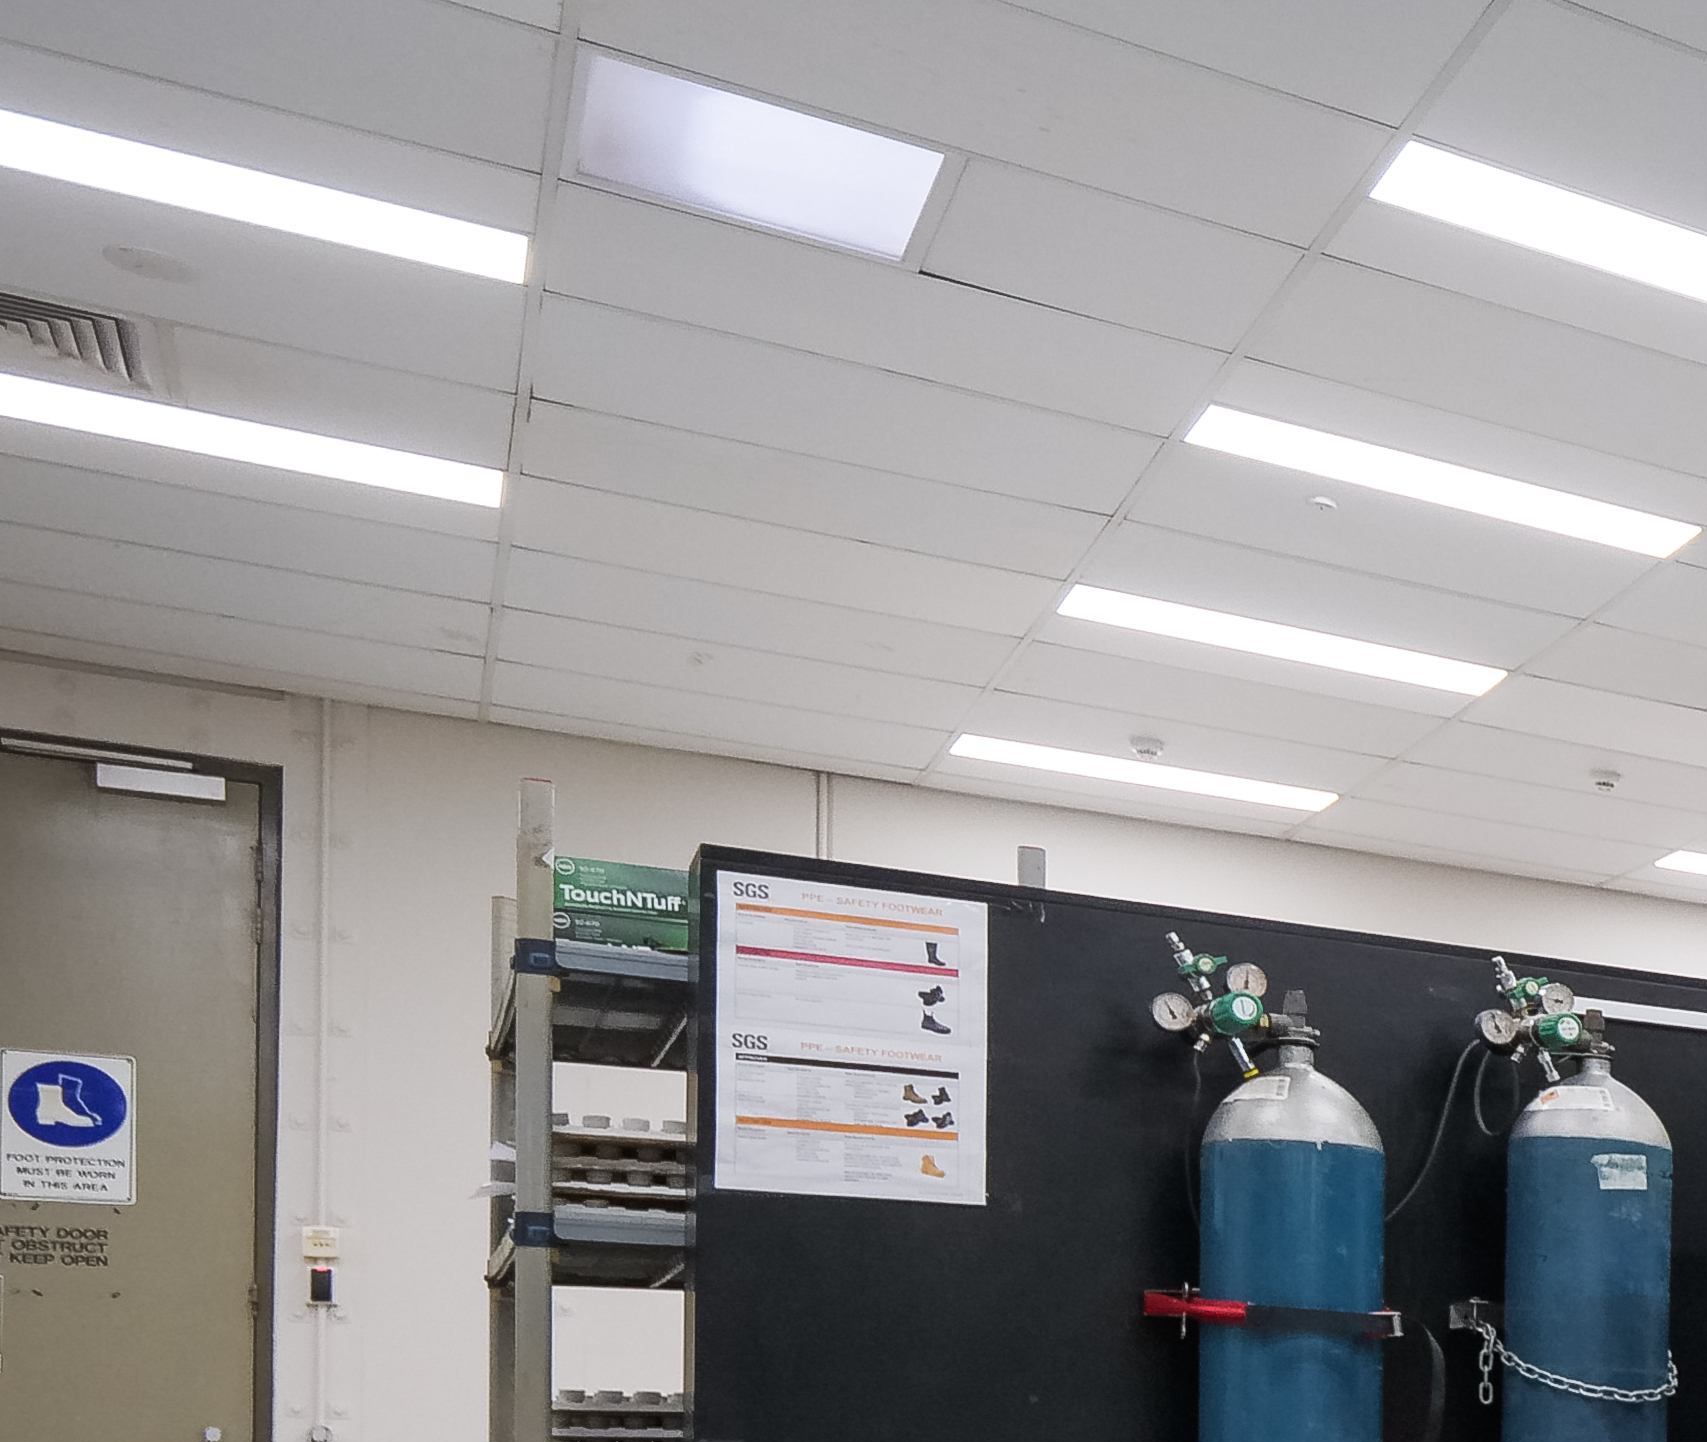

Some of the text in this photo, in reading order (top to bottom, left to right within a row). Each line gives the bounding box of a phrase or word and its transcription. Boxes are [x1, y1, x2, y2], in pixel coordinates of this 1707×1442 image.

[559, 883, 682, 912] TouchNTuff
[732, 881, 769, 900] SGS
[802, 892, 943, 917] PPE SAFETY FOOTWEAR
[731, 1032, 768, 1050] SGS
[800, 1041, 943, 1063] PPE SAFETY FOOTWEAR
[6, 1153, 125, 1168] FOOT PROTECTION
[16, 1166, 117, 1180] MUST BE WORN
[23, 1179, 109, 1192] IN THIS AREA
[56, 1227, 109, 1240] DOOR
[11, 1239, 109, 1254] OBSTRUCT
[9, 1252, 108, 1267] KEEP OPEN
